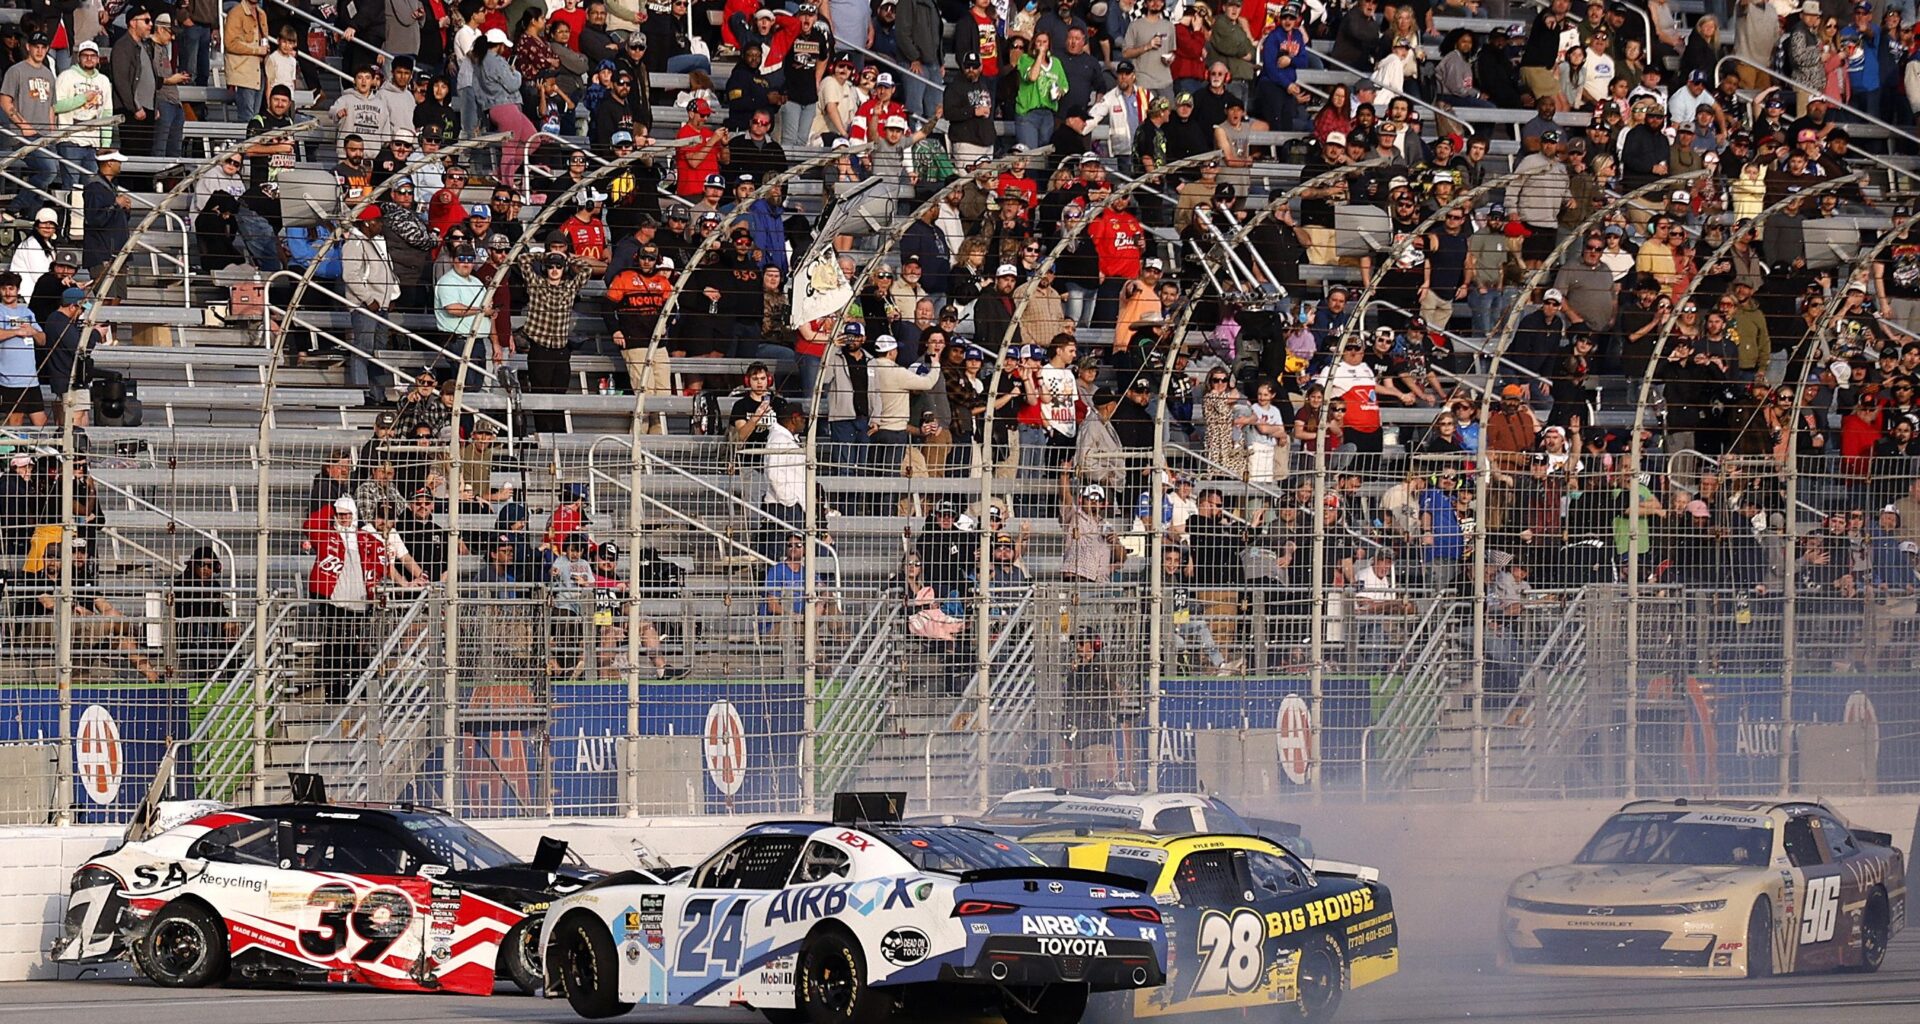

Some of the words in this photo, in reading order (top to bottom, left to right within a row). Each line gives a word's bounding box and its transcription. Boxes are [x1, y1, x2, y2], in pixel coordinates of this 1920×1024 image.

[354, 104, 381, 113] CALIFORNIA
[1066, 803, 1132, 817] STAROPOLI
[1700, 814, 1757, 824] ALFREDO
[836, 831, 874, 852] DEX
[1117, 848, 1151, 858] SIEG
[133, 862, 188, 890] SA
[199, 873, 262, 892] Recycling
[765, 878, 916, 927] AIRBOX
[1090, 889, 1106, 899] GR
[522, 902, 550, 913] GOOD
[1265, 908, 1306, 938] BIG
[1305, 887, 1375, 927] HOUSE
[1800, 875, 1841, 945] 96
[298, 882, 416, 963] 39
[1022, 914, 1115, 937] AIRBOX
[233, 925, 251, 937] MADE
[258, 934, 286, 949] AMERICA
[676, 896, 753, 976] 24
[903, 938, 917, 948] DEAD
[917, 938, 926, 948] ON
[1139, 927, 1157, 941] 24
[903, 948, 925, 957] TOOLS
[1037, 938, 1108, 957] TOYOTA
[1194, 909, 1264, 996] 28
[1718, 943, 1744, 951] ARP
[761, 972, 784, 985] Mobil
